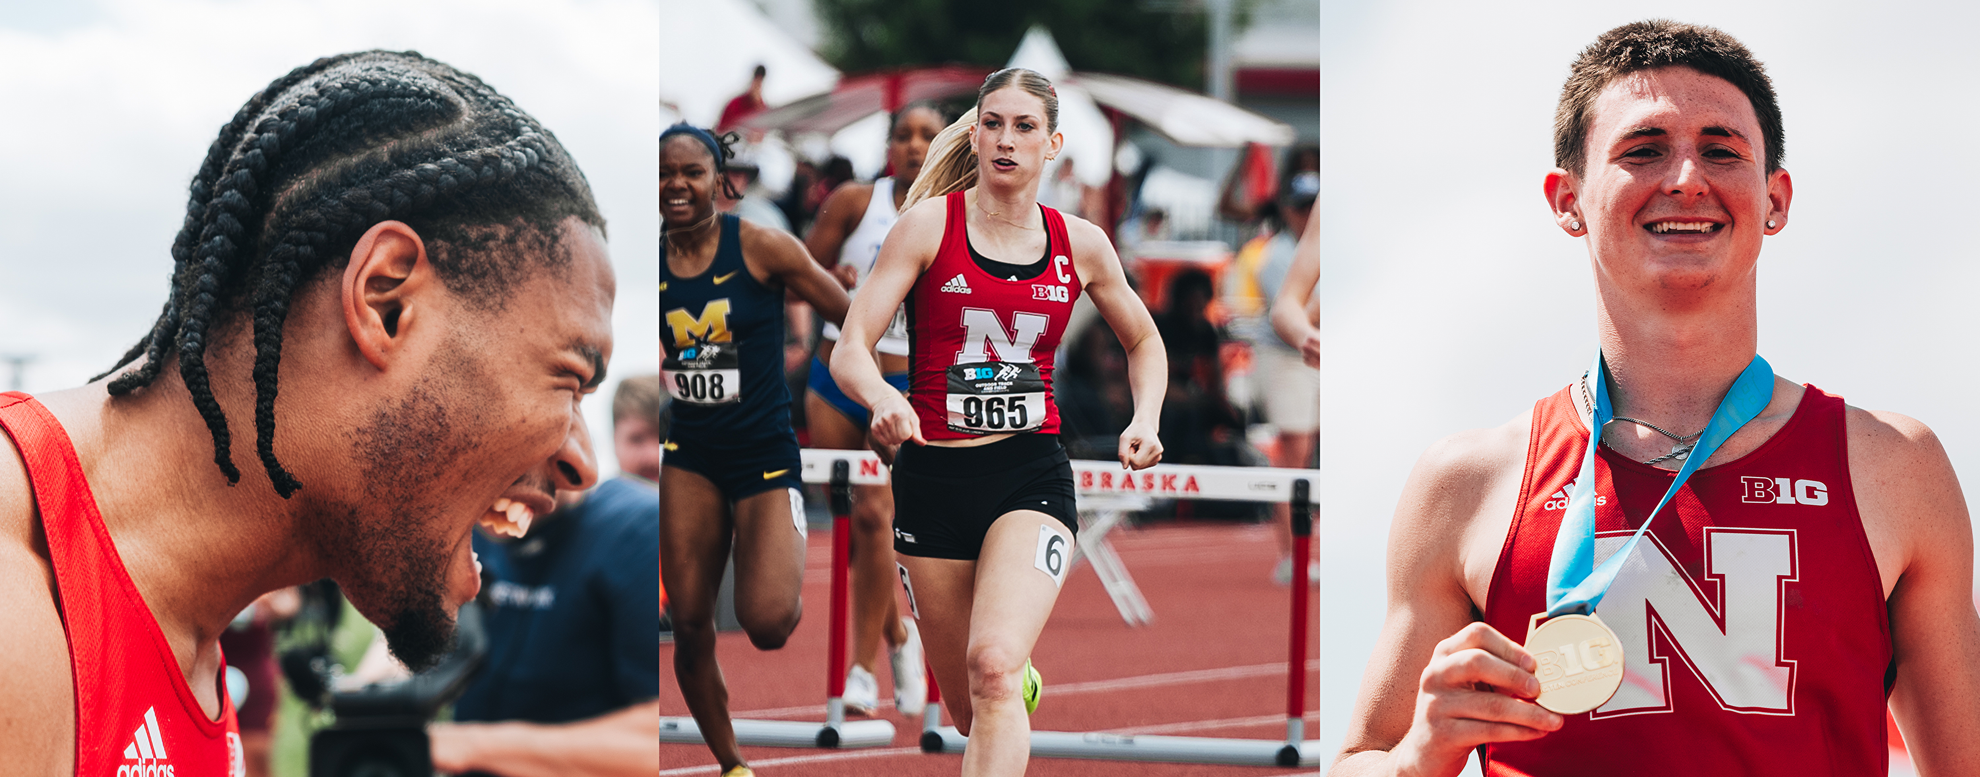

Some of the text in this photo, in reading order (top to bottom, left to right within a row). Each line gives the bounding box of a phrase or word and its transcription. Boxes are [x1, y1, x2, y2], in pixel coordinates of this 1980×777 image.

[1054, 255, 1071, 284] C
[941, 284, 972, 294] adidas
[665, 297, 732, 348] M
[954, 306, 1050, 365] N
[674, 373, 724, 400] 908
[963, 395, 1028, 430] 965
[860, 459, 879, 476] N
[1045, 534, 1065, 577] 6
[1590, 526, 1799, 721] N
[117, 757, 175, 777] adidas
